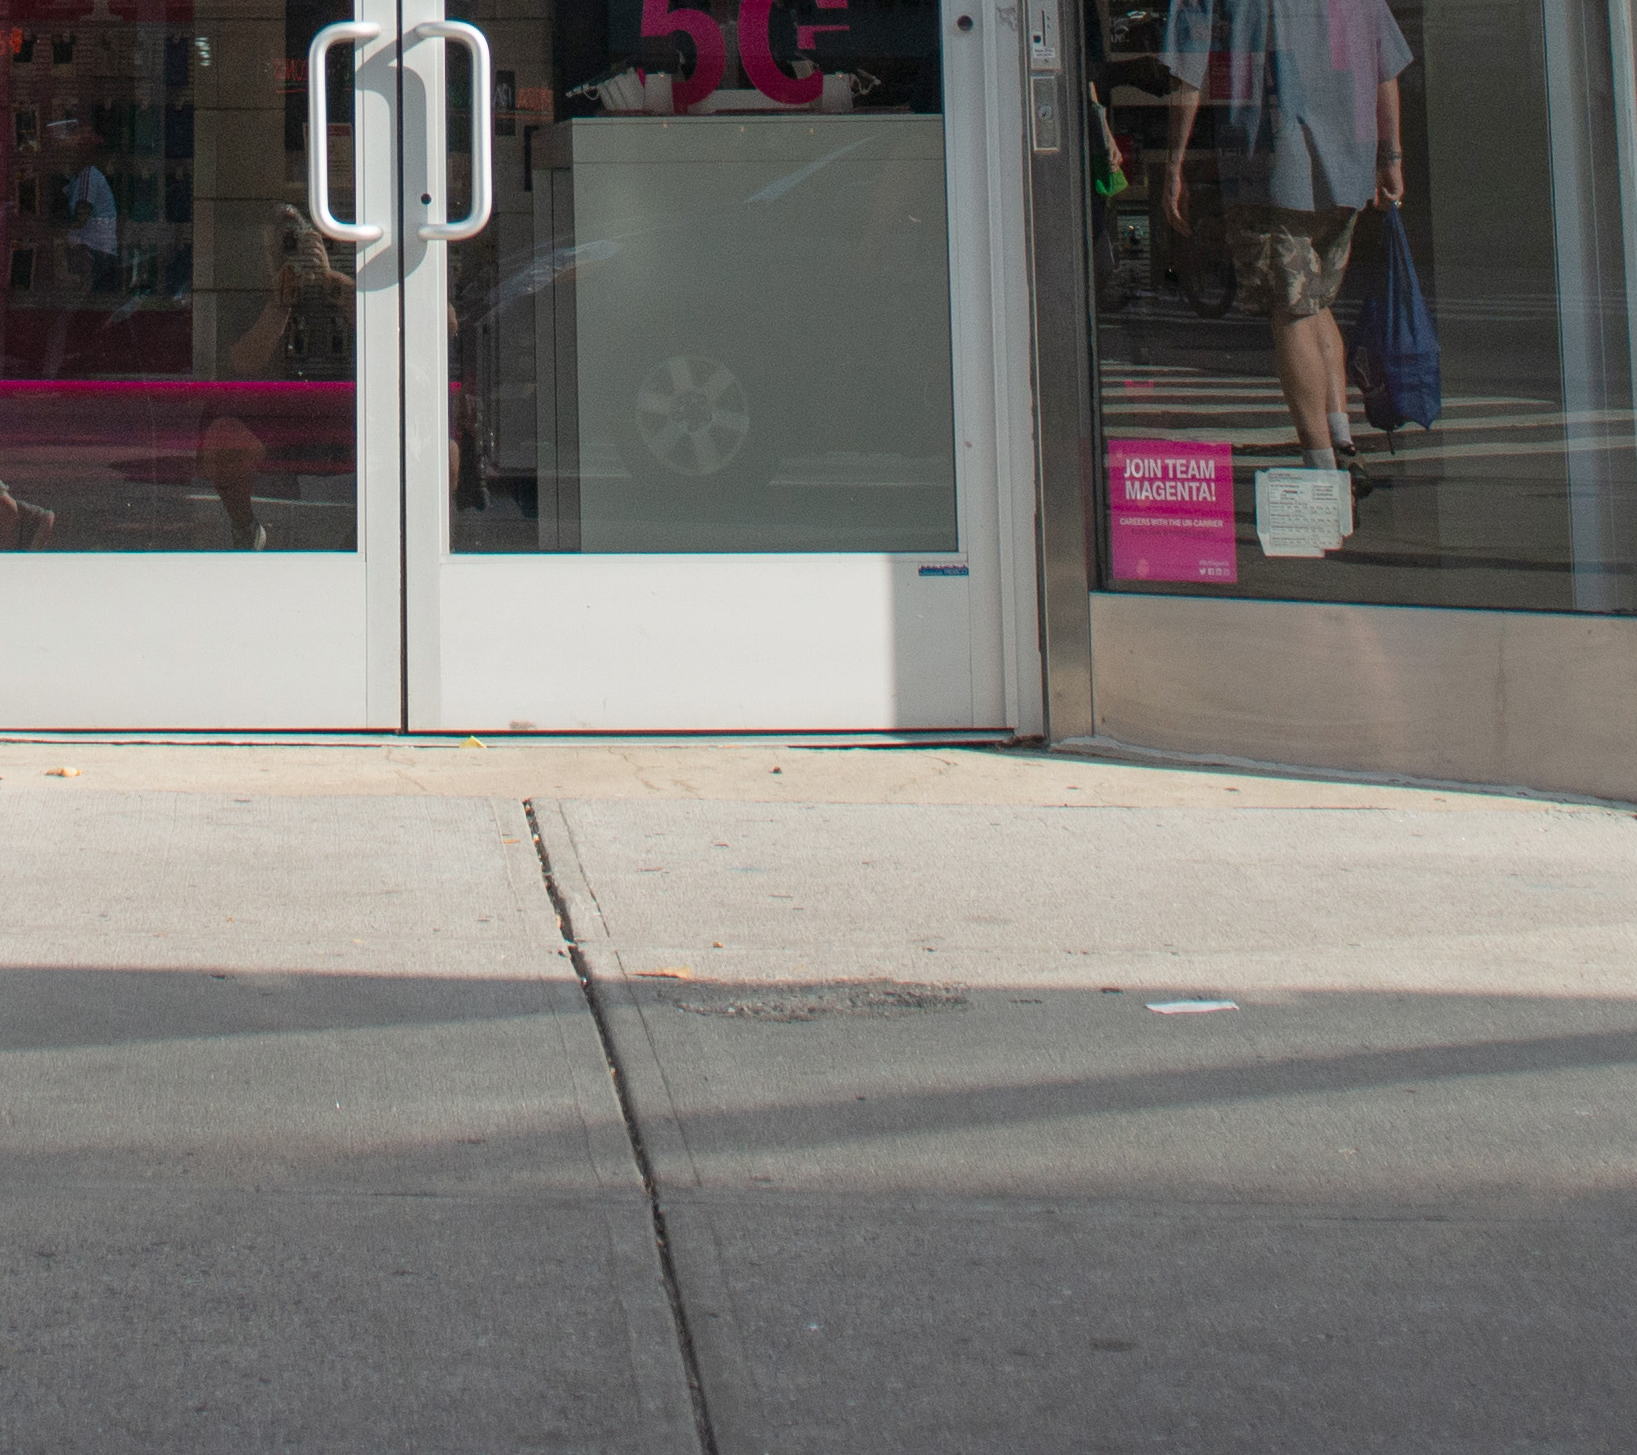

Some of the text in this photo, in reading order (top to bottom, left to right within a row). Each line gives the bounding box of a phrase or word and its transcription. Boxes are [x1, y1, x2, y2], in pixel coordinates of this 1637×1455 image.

[1124, 459, 1215, 479] JOIN TEAM
[1126, 481, 1216, 501] MAGENTA!
